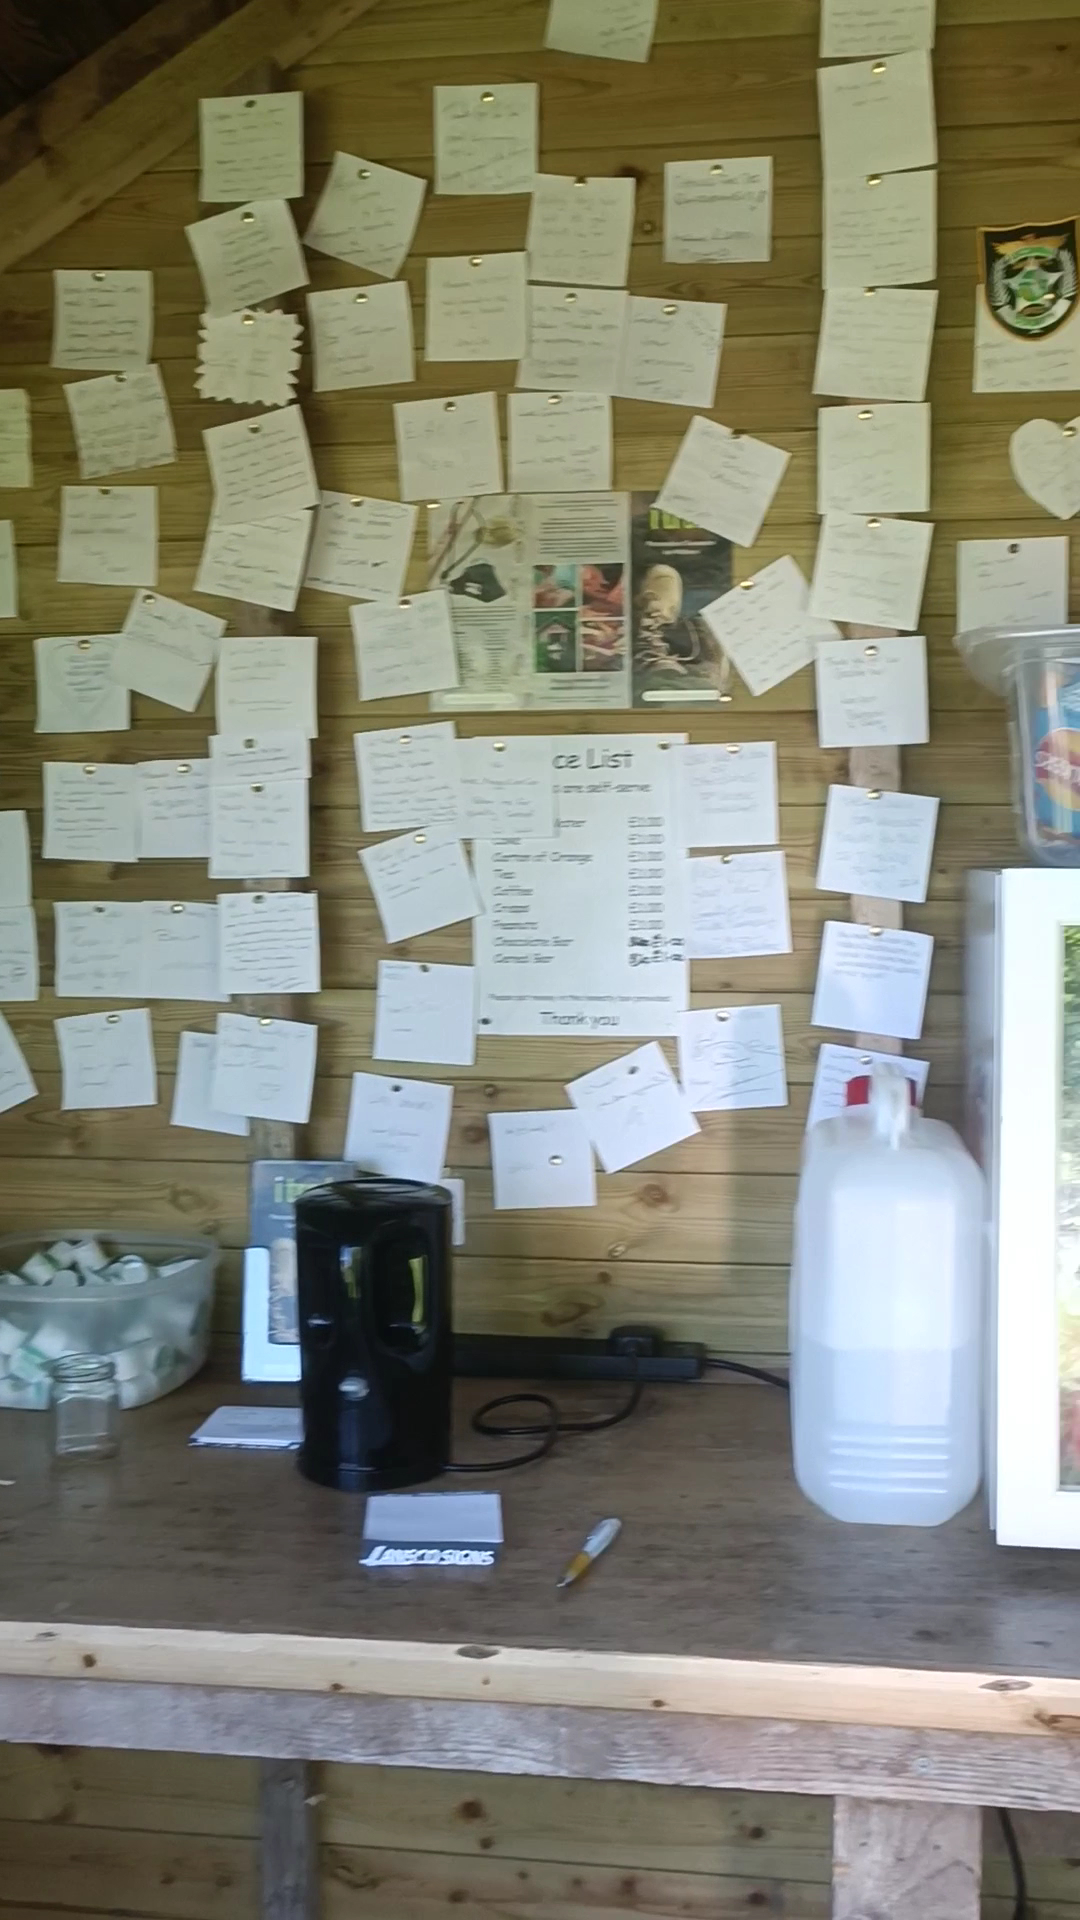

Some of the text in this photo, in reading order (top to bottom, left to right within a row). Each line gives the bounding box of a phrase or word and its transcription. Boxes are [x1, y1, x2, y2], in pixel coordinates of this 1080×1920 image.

[586, 747, 634, 770] List
[539, 1011, 621, 1029] Thank you
